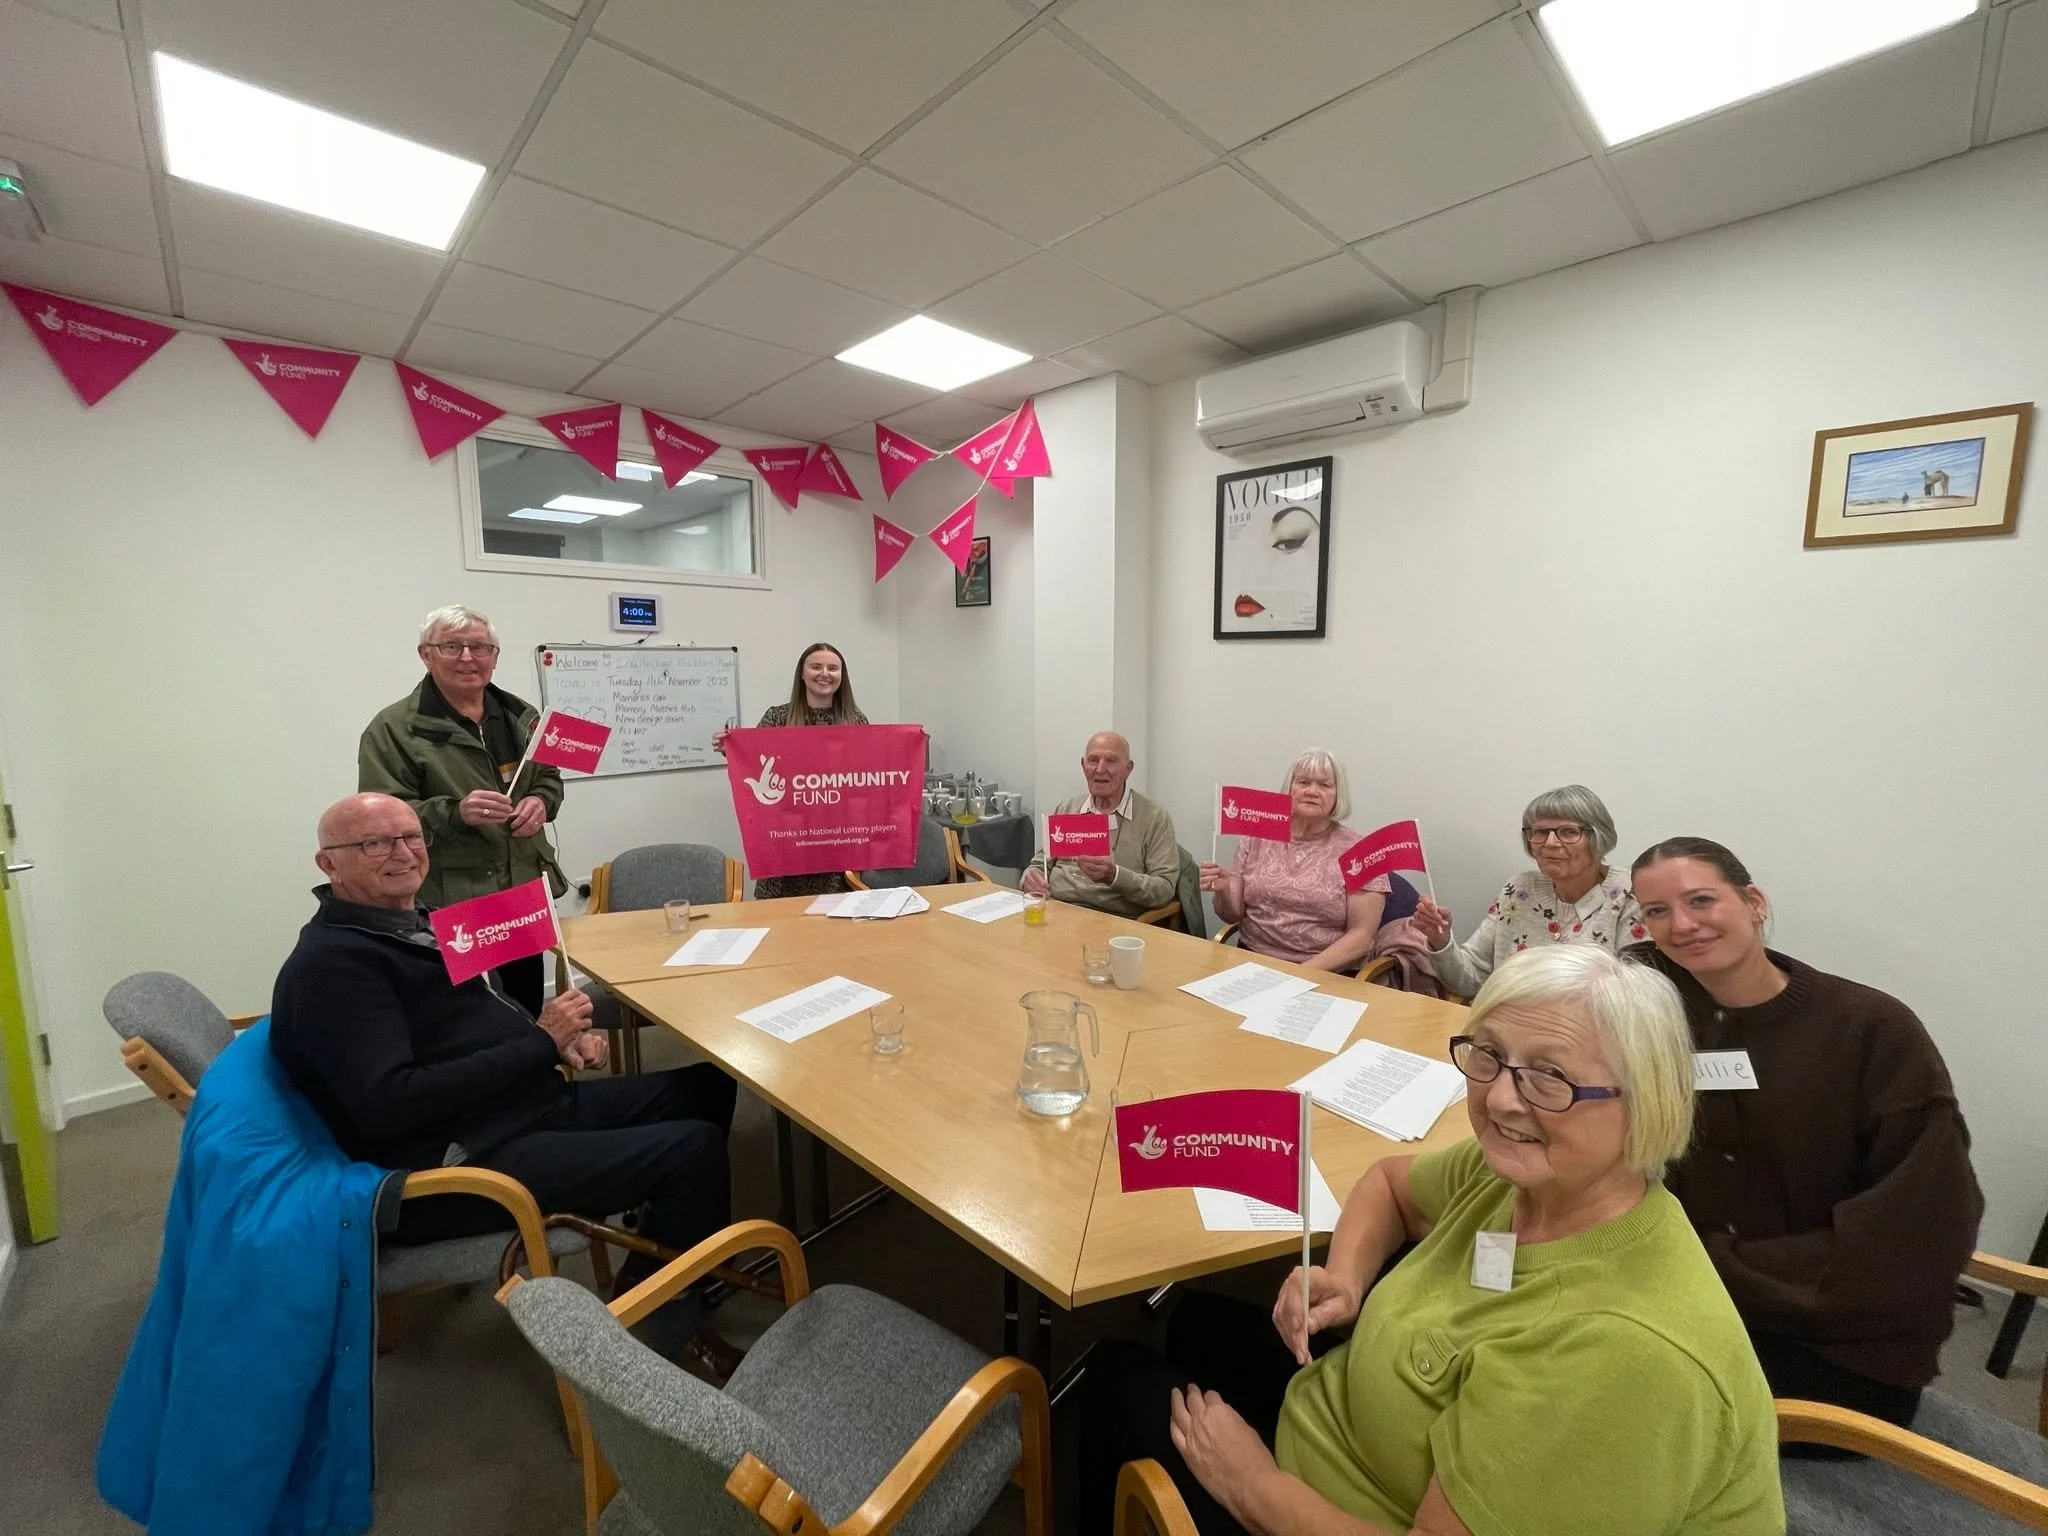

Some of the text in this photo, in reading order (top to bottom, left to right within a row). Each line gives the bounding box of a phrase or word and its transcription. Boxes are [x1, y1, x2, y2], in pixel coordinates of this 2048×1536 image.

[67, 320, 148, 346] COMMUNITY
[67, 327, 101, 342] FUND
[279, 363, 340, 377] COMMUNITY
[280, 371, 306, 379] FUND
[429, 400, 451, 414] FUND
[431, 394, 482, 420] COMMUNITY
[575, 420, 613, 431] COMMUNITY
[667, 434, 704, 455] COMMUNITY
[1227, 468, 1320, 510] VOGUE
[623, 608, 644, 616] 4:00
[555, 653, 600, 669] Welcome
[606, 674, 642, 696] Tuesday
[668, 676, 701, 687] November
[707, 675, 729, 687] 2025
[615, 702, 647, 714] Memory
[556, 744, 576, 753] FUND
[560, 738, 603, 753] COMMUNITY
[792, 771, 910, 790] COMMUNITY
[793, 790, 841, 806] FUND
[1240, 808, 1289, 822] COMMUNITY
[1240, 814, 1260, 823] FUND
[769, 823, 897, 839] Thanks to National Lottery players
[1364, 841, 1419, 863] COMMUNITY
[1364, 854, 1386, 869] FUND
[476, 907, 548, 940] COMMUNITY
[477, 931, 510, 948] FUND
[1173, 1133, 1295, 1156] COMMUNITY
[1173, 1146, 1220, 1159] FUND
